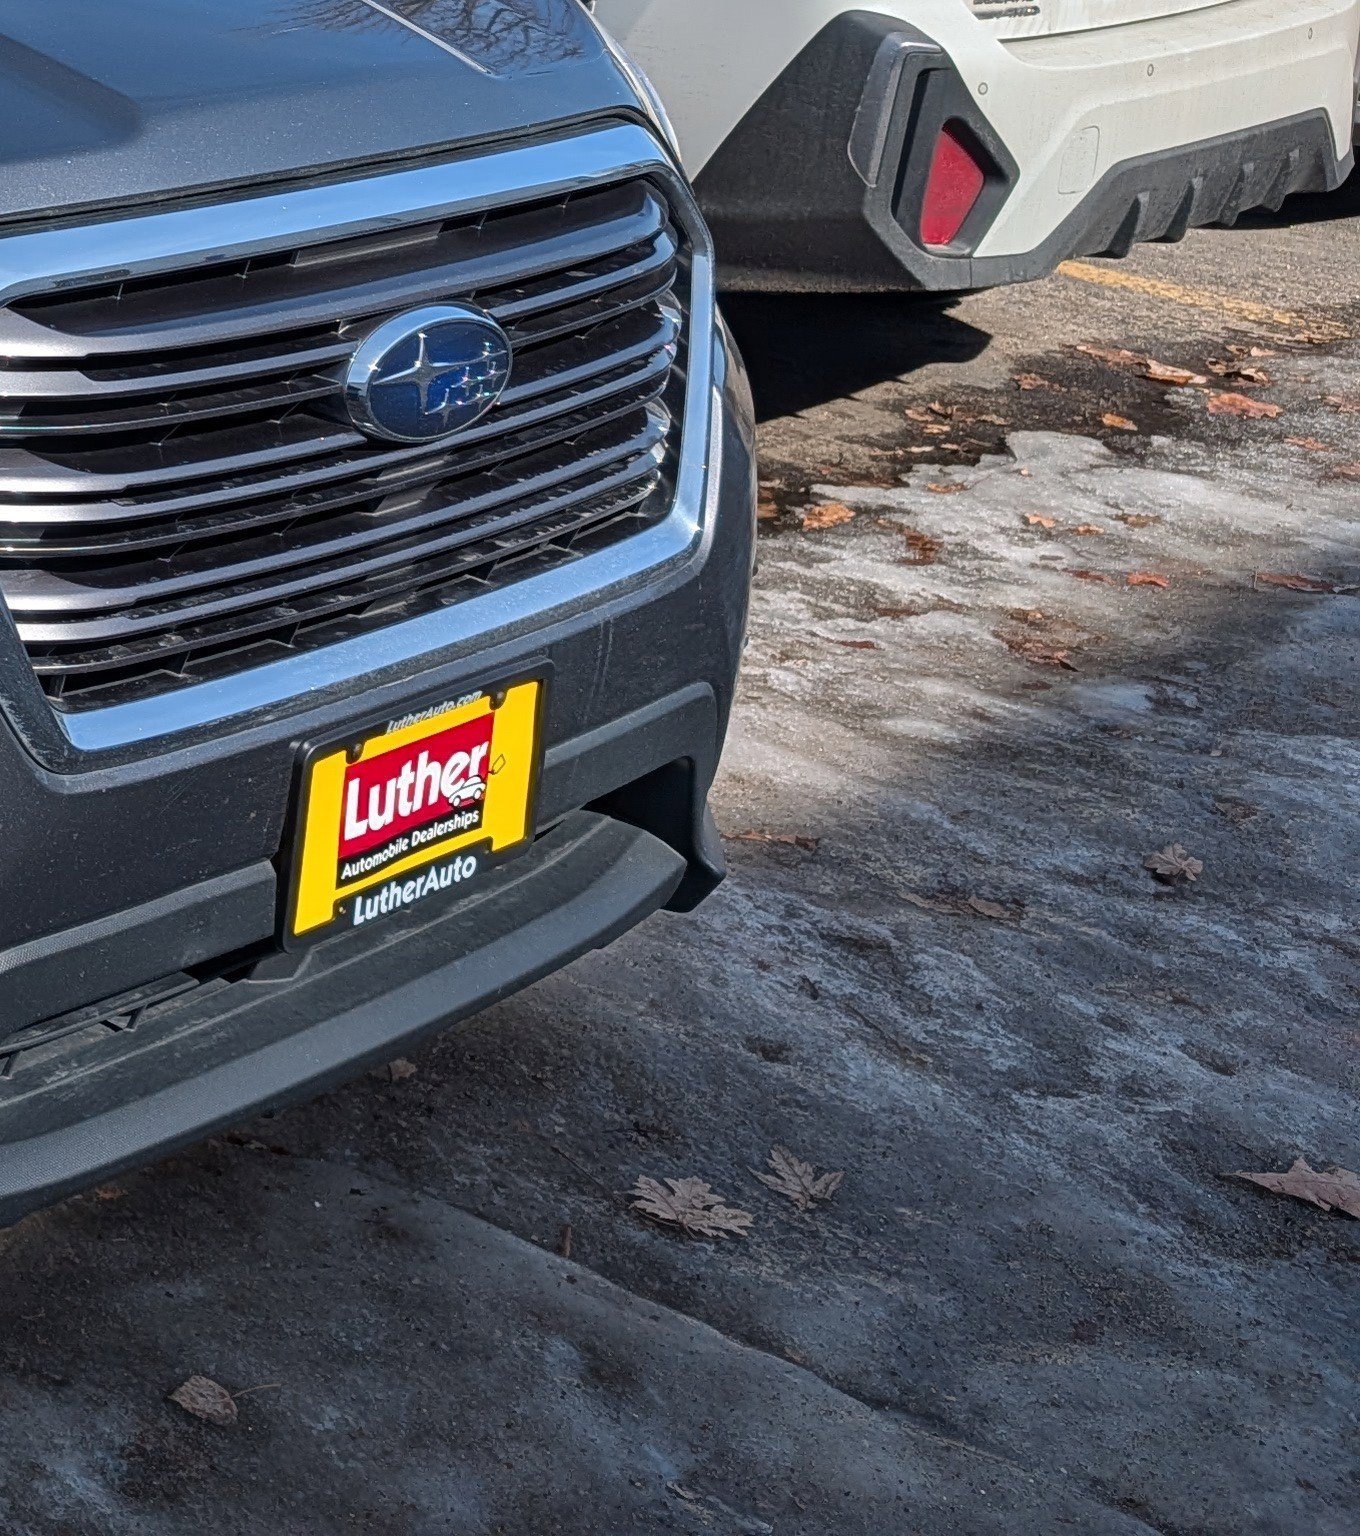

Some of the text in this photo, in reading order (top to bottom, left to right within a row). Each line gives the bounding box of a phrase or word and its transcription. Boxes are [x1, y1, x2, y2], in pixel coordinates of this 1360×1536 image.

[385, 690, 483, 735] LutherAuto.com
[343, 740, 490, 842] Luther
[340, 809, 480, 880] Automobile Dealerships
[352, 854, 478, 926] LutherAuto
